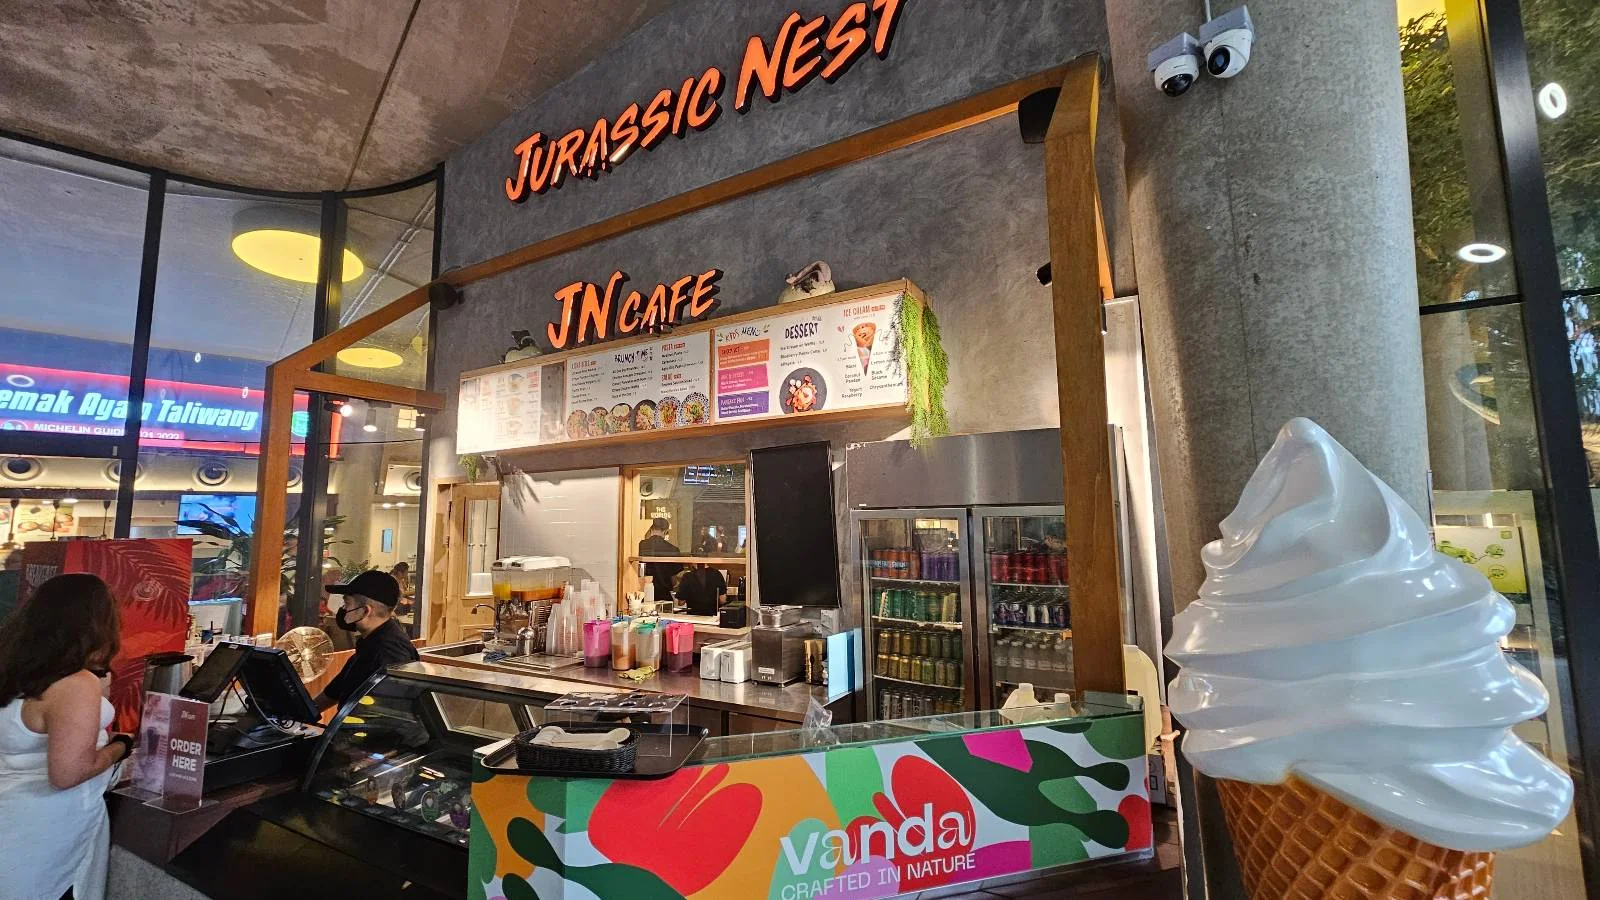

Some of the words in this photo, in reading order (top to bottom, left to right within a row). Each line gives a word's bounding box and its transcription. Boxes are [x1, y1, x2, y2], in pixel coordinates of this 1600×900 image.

[505, 67, 721, 200] JURASSIC
[735, 0, 904, 109] NEST
[547, 271, 621, 347] JN
[619, 270, 717, 331] CAFE
[785, 322, 818, 339] DESSERT
[157, 400, 259, 430] Taliwang
[170, 738, 201, 755] ORDER
[172, 754, 197, 771] HERE
[780, 802, 971, 876] vanda
[781, 871, 871, 900] CRAFTED
[878, 865, 900, 885] IN
[907, 852, 975, 881] NATURE
